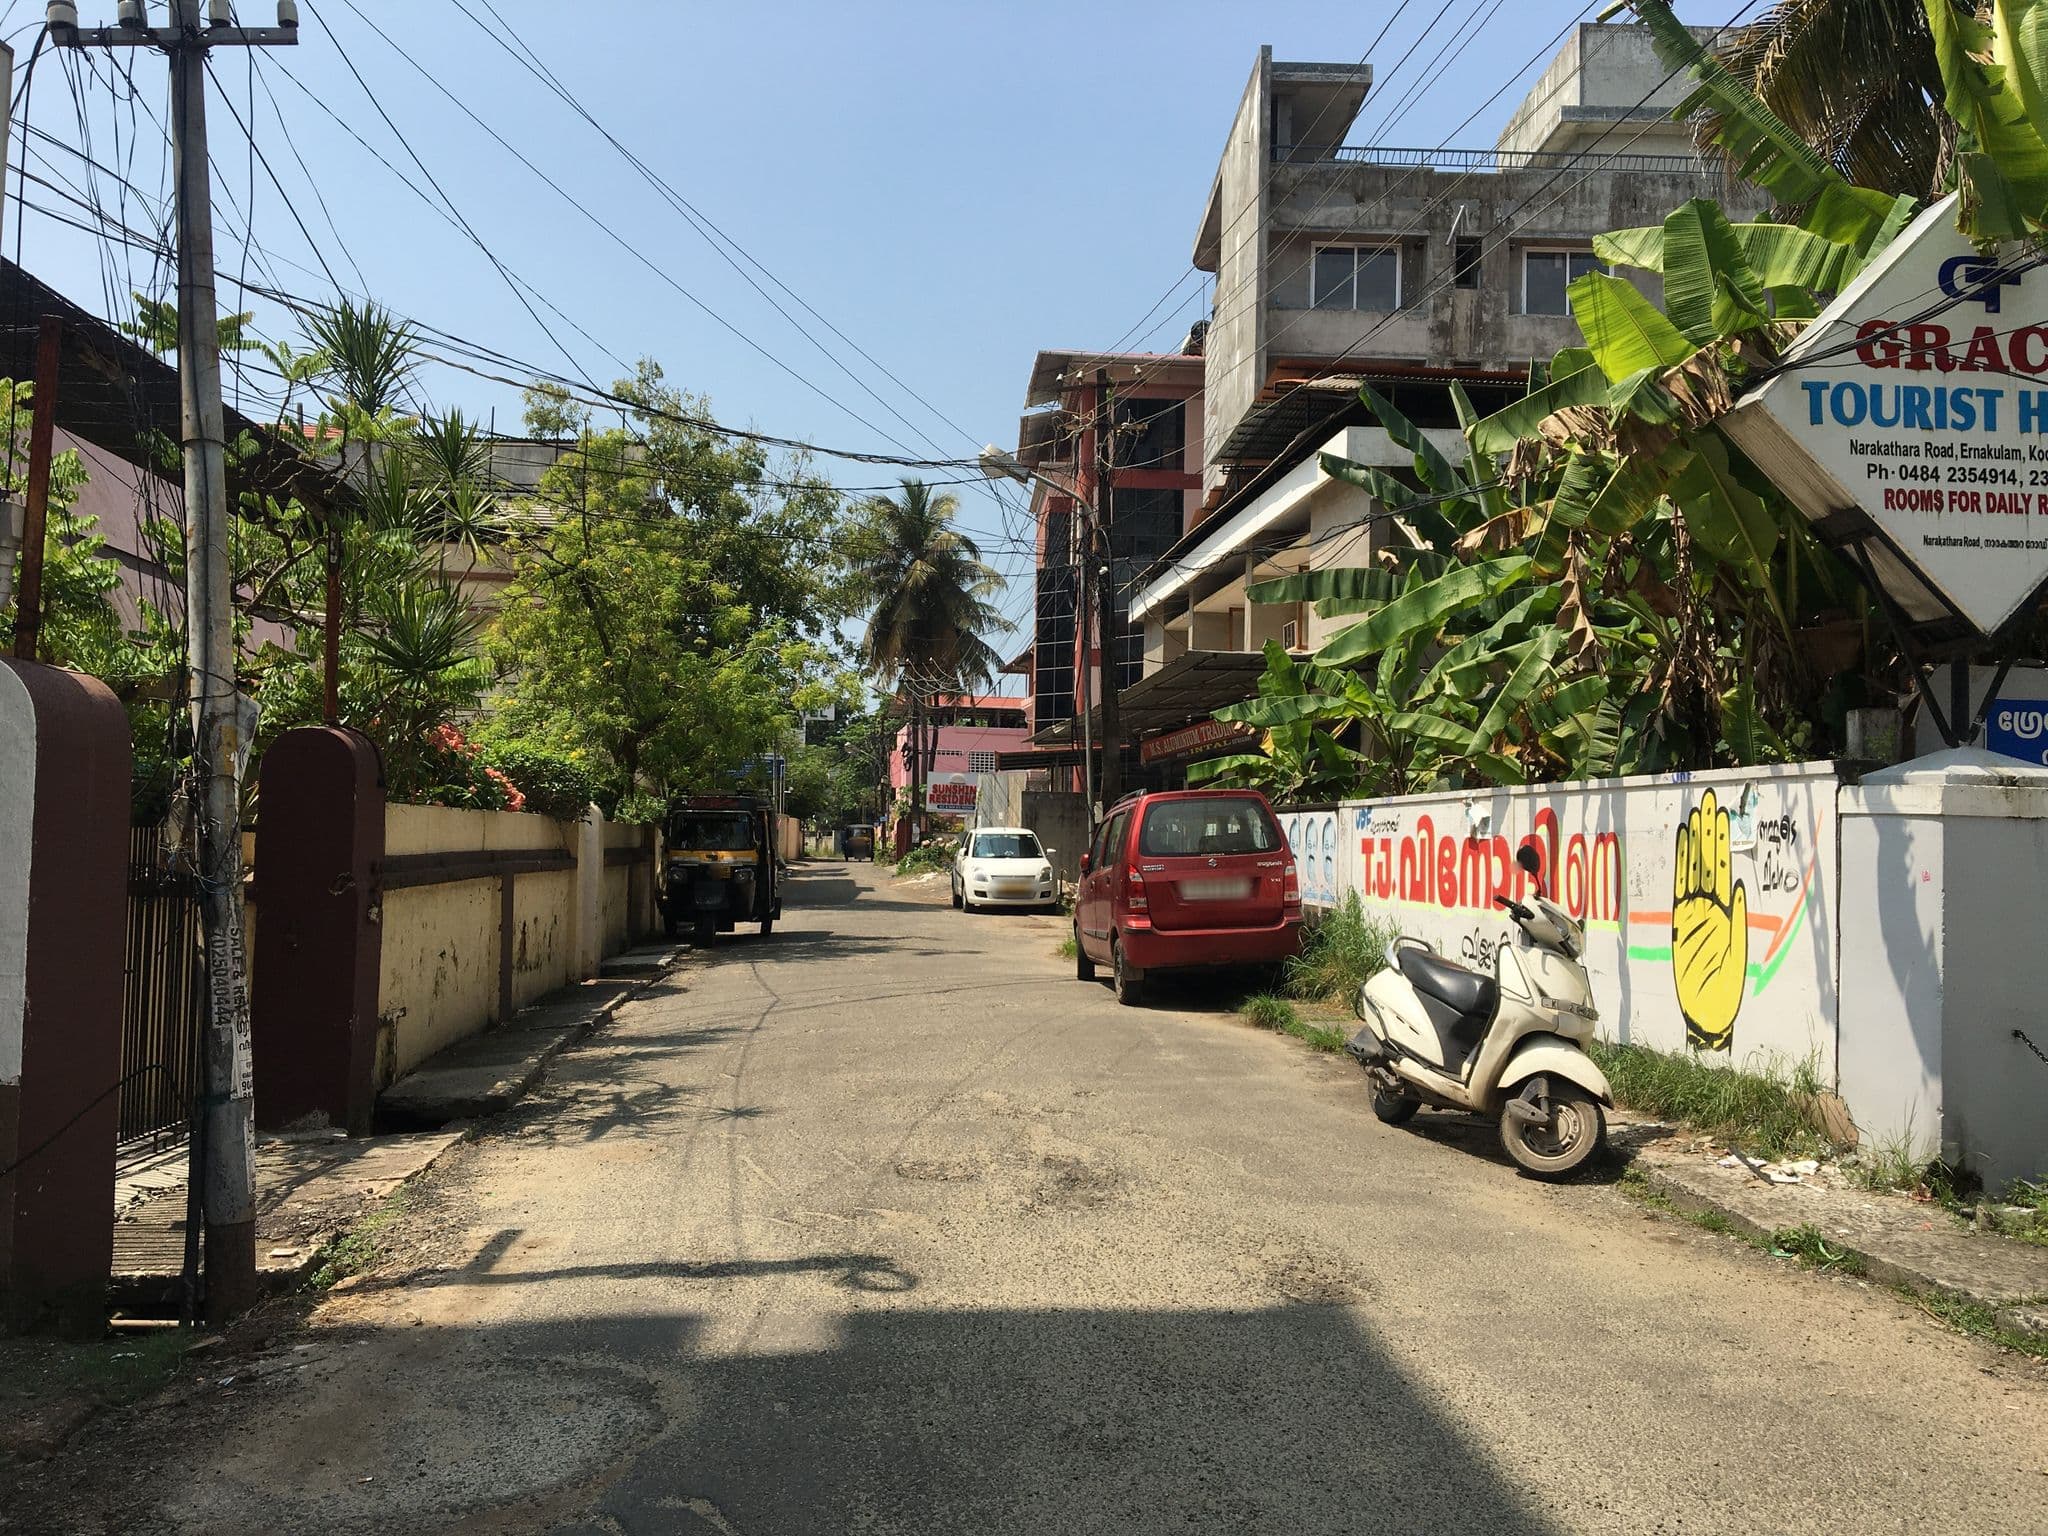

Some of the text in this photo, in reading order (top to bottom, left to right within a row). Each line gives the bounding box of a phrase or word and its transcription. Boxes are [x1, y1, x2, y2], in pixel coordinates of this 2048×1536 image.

[1801, 381, 2004, 432] TOURIST
[1849, 440, 1921, 457] Narakathara
[1924, 441, 1959, 461] Road,
[1960, 443, 2027, 464] Ernakulam,
[1884, 488, 1945, 513] ROOMS
[1948, 490, 1982, 515] FOR
[1985, 492, 2033, 515] DAILY
[230, 927, 243, 966] SALE
